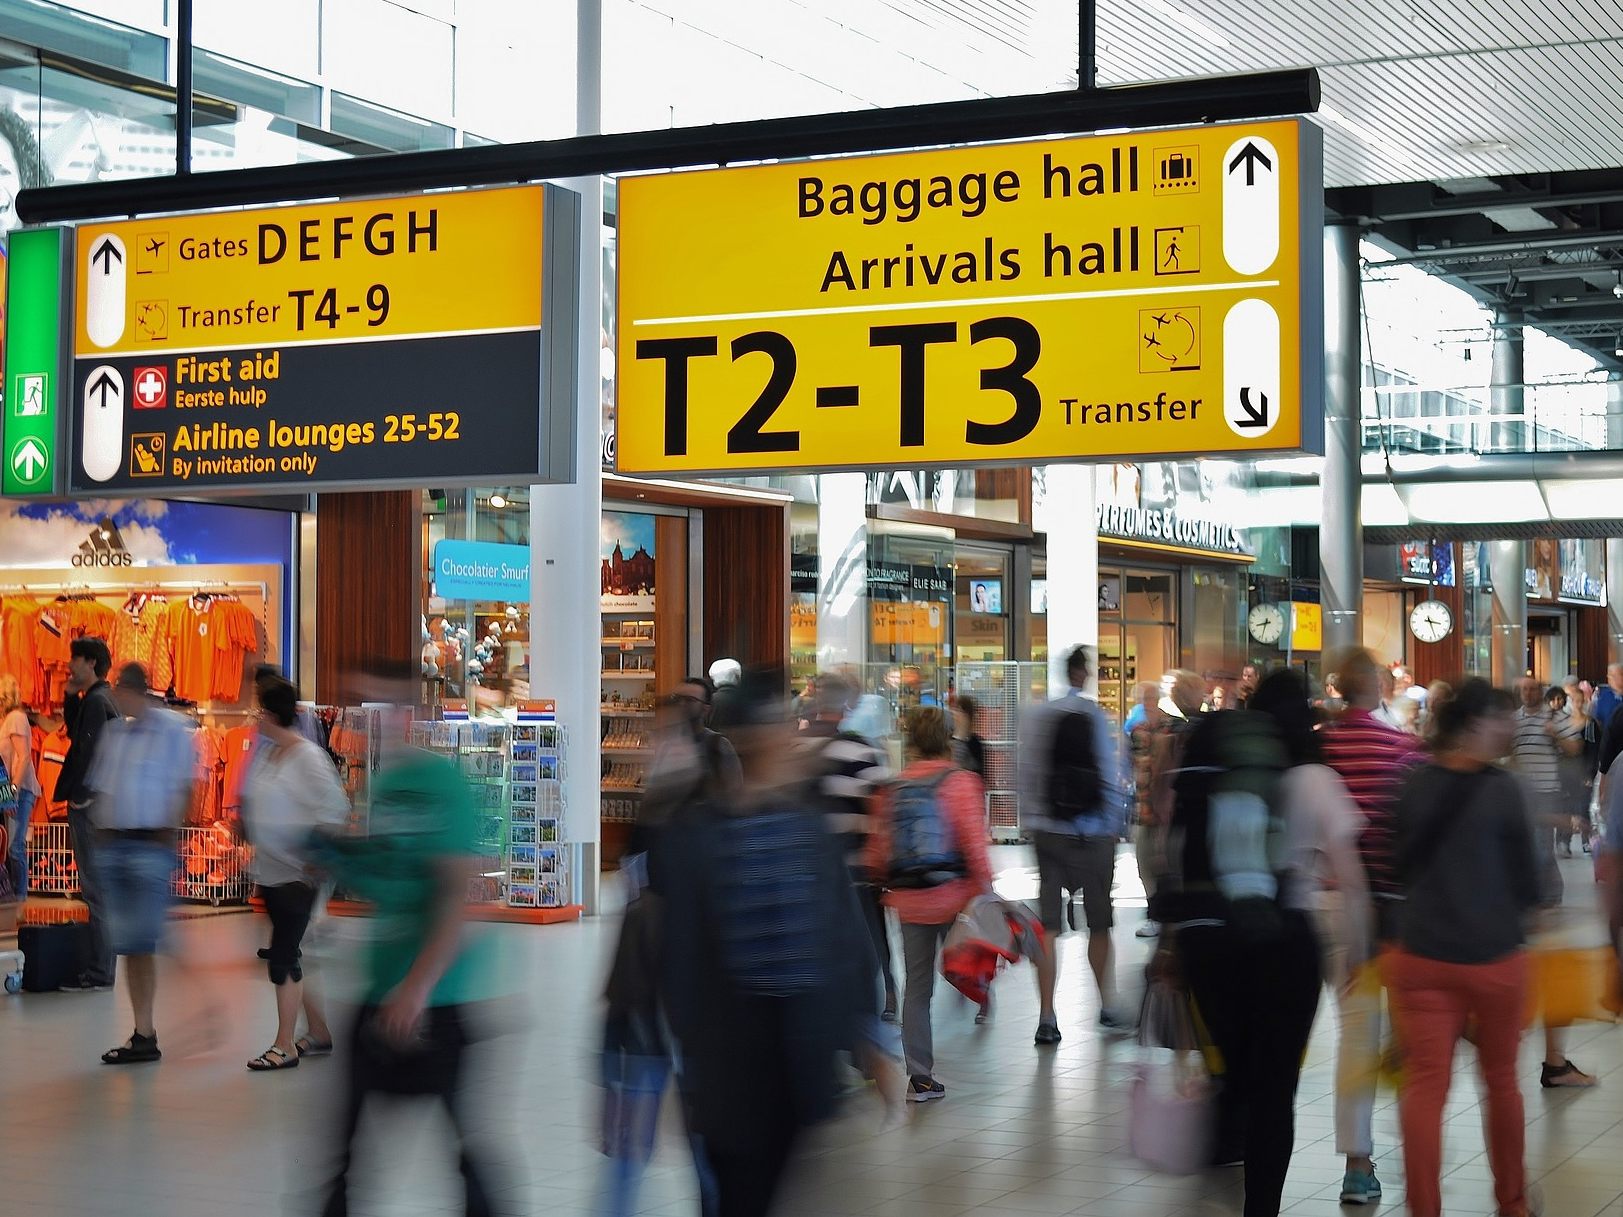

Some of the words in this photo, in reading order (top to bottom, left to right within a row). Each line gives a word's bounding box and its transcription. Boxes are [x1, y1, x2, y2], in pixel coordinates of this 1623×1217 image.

[798, 172, 1020, 225] Baggage
[1043, 147, 1138, 198] hall
[179, 237, 248, 261] Gates
[820, 236, 1021, 293] Arrivals
[1044, 226, 1139, 278] hall
[177, 301, 281, 328] Transfer
[288, 283, 390, 331] T4-9
[175, 355, 232, 384] First
[240, 350, 281, 380] aid
[175, 389, 224, 408] Eerste
[229, 385, 267, 411] hulp
[635, 316, 1043, 457] T2-T3
[1059, 392, 1203, 425] Transfer
[172, 422, 260, 453] Airline
[268, 418, 375, 452] lounges
[383, 411, 460, 443] 25-52
[172, 457, 192, 480] By
[197, 454, 276, 474] invitation
[280, 451, 317, 475] only
[1096, 503, 1161, 537] PERFUMES
[1175, 519, 1238, 548] COSMETICS
[71, 550, 132, 567] adidas
[441, 558, 498, 578] Chocolatier
[913, 577, 929, 590] ELIE
[971, 619, 998, 632] Skin
